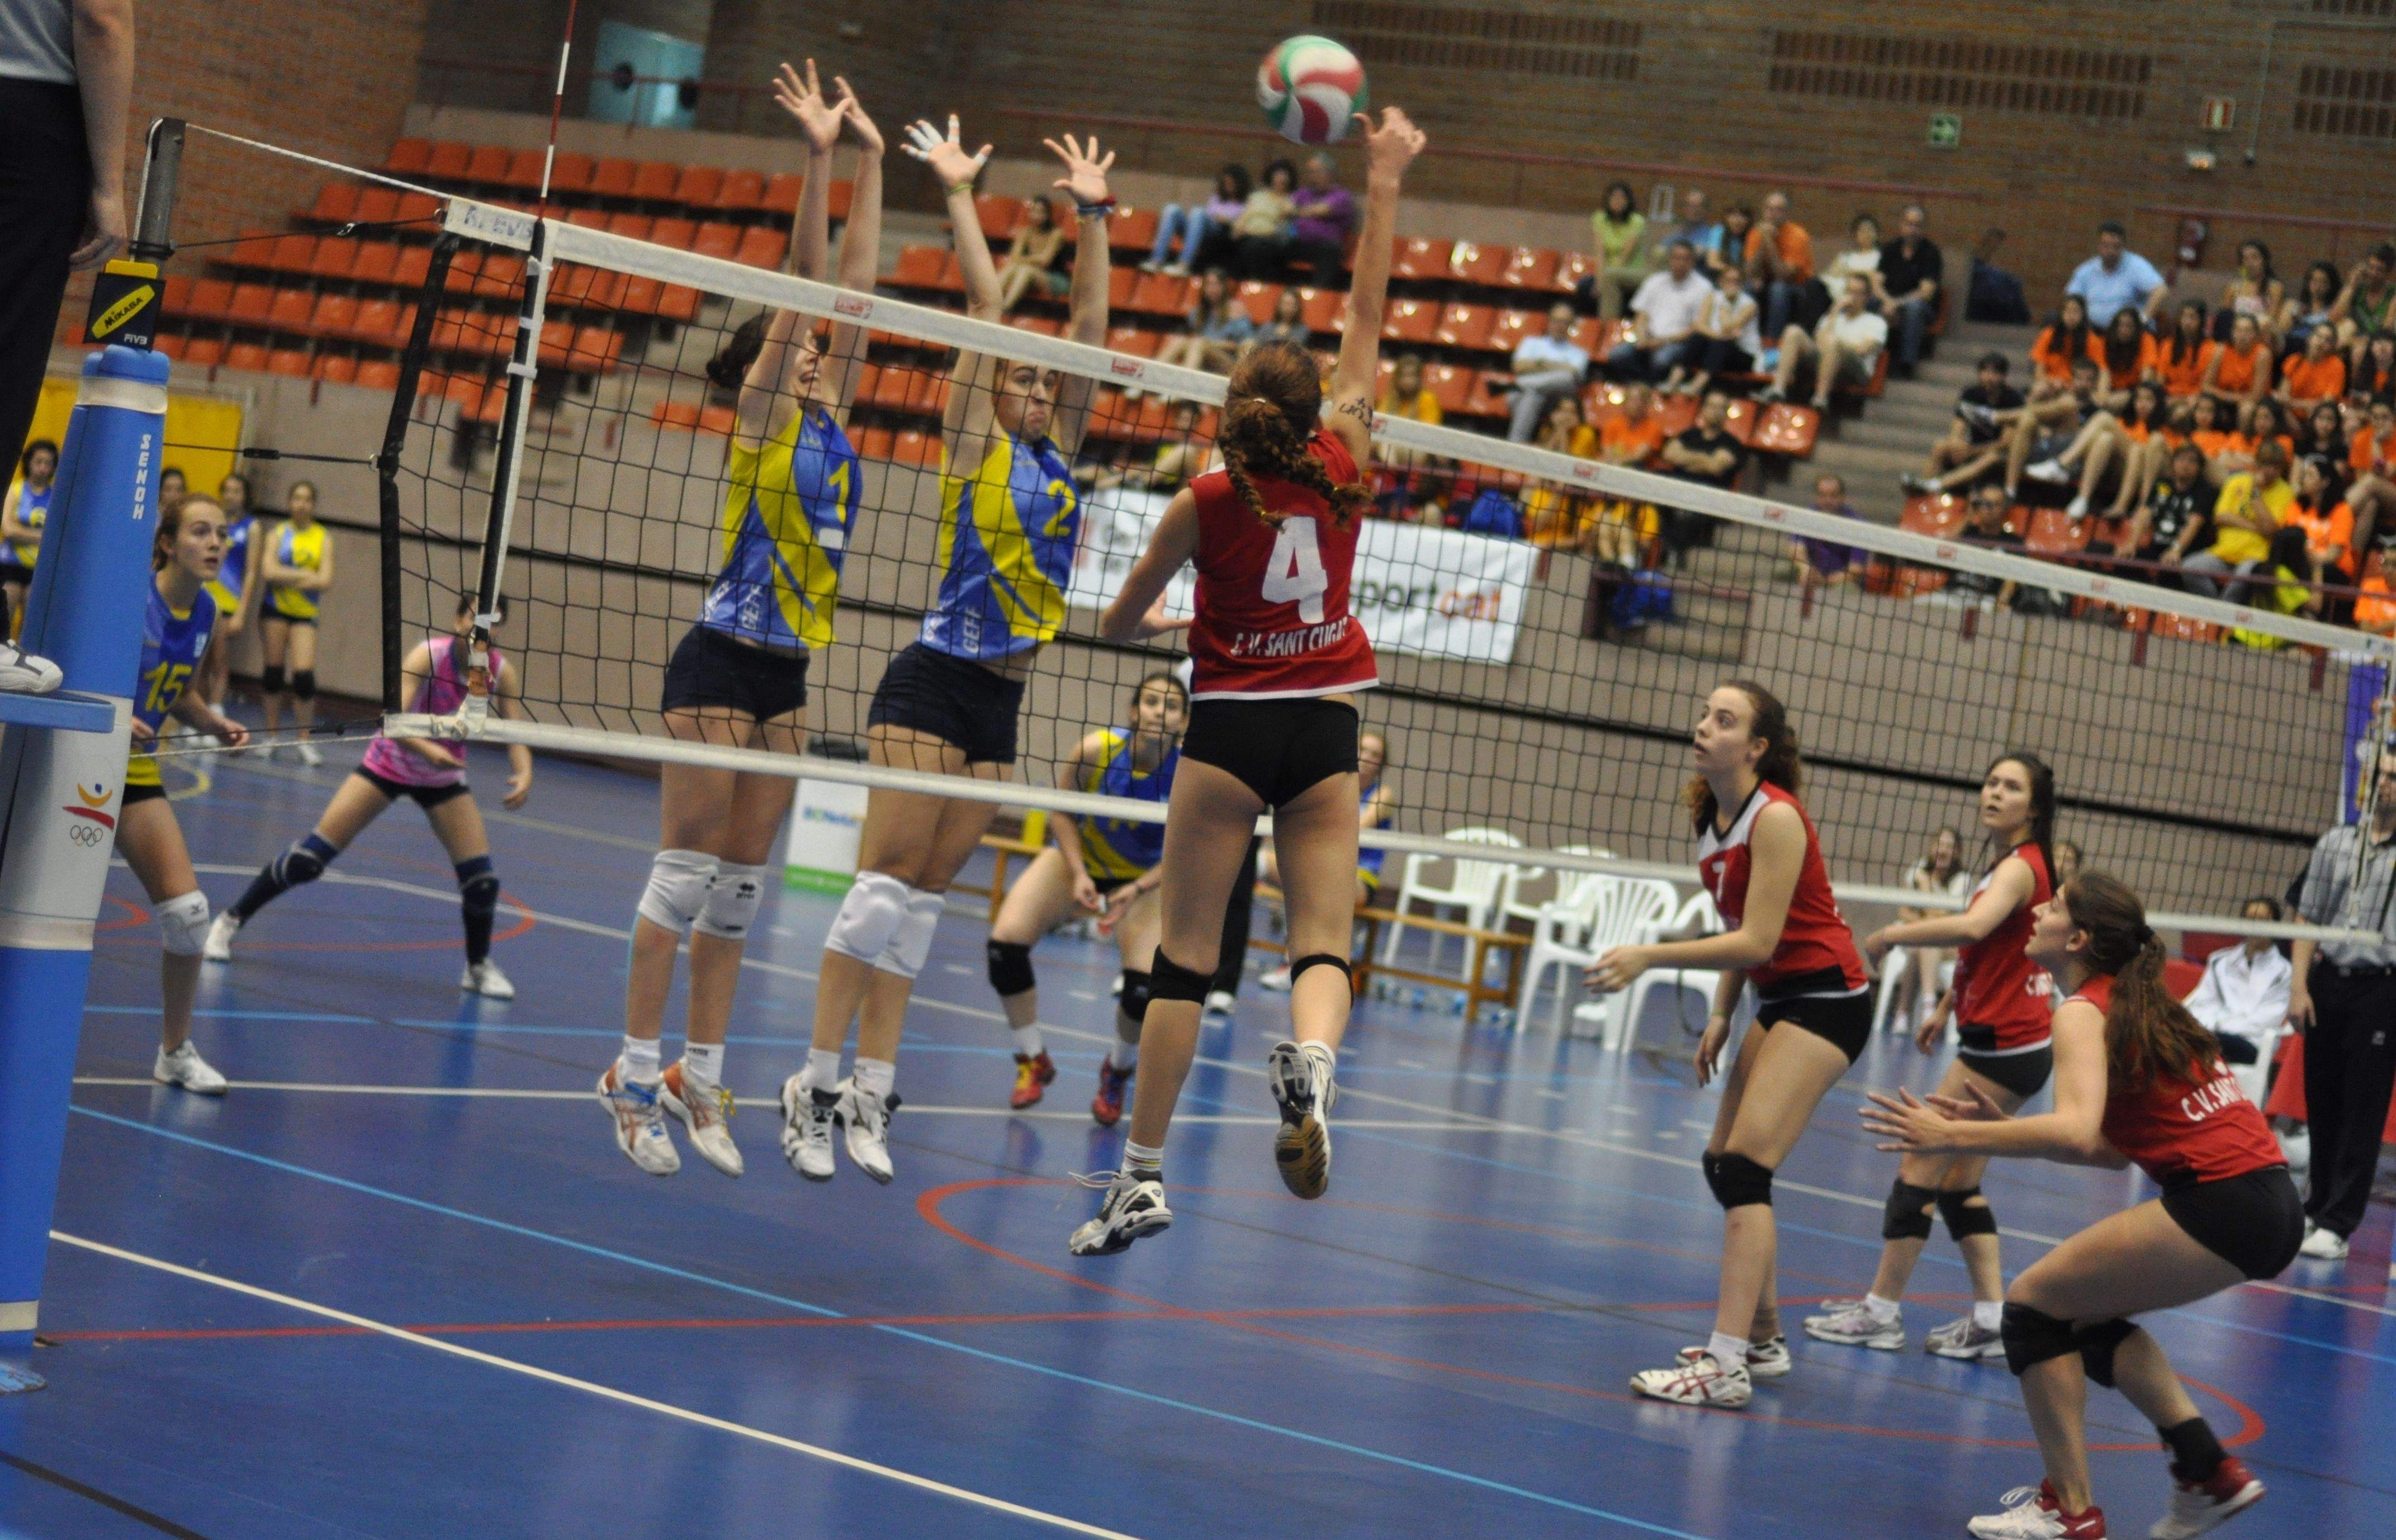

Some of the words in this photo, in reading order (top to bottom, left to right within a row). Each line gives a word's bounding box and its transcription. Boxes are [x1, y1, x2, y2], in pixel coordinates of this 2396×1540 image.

[124, 334, 148, 345] FIVB
[132, 434, 151, 520] SENOH
[1043, 479, 1076, 536] 2
[1262, 516, 1328, 624] 4
[1265, 629, 1307, 657] SANT
[144, 661, 192, 713] 15
